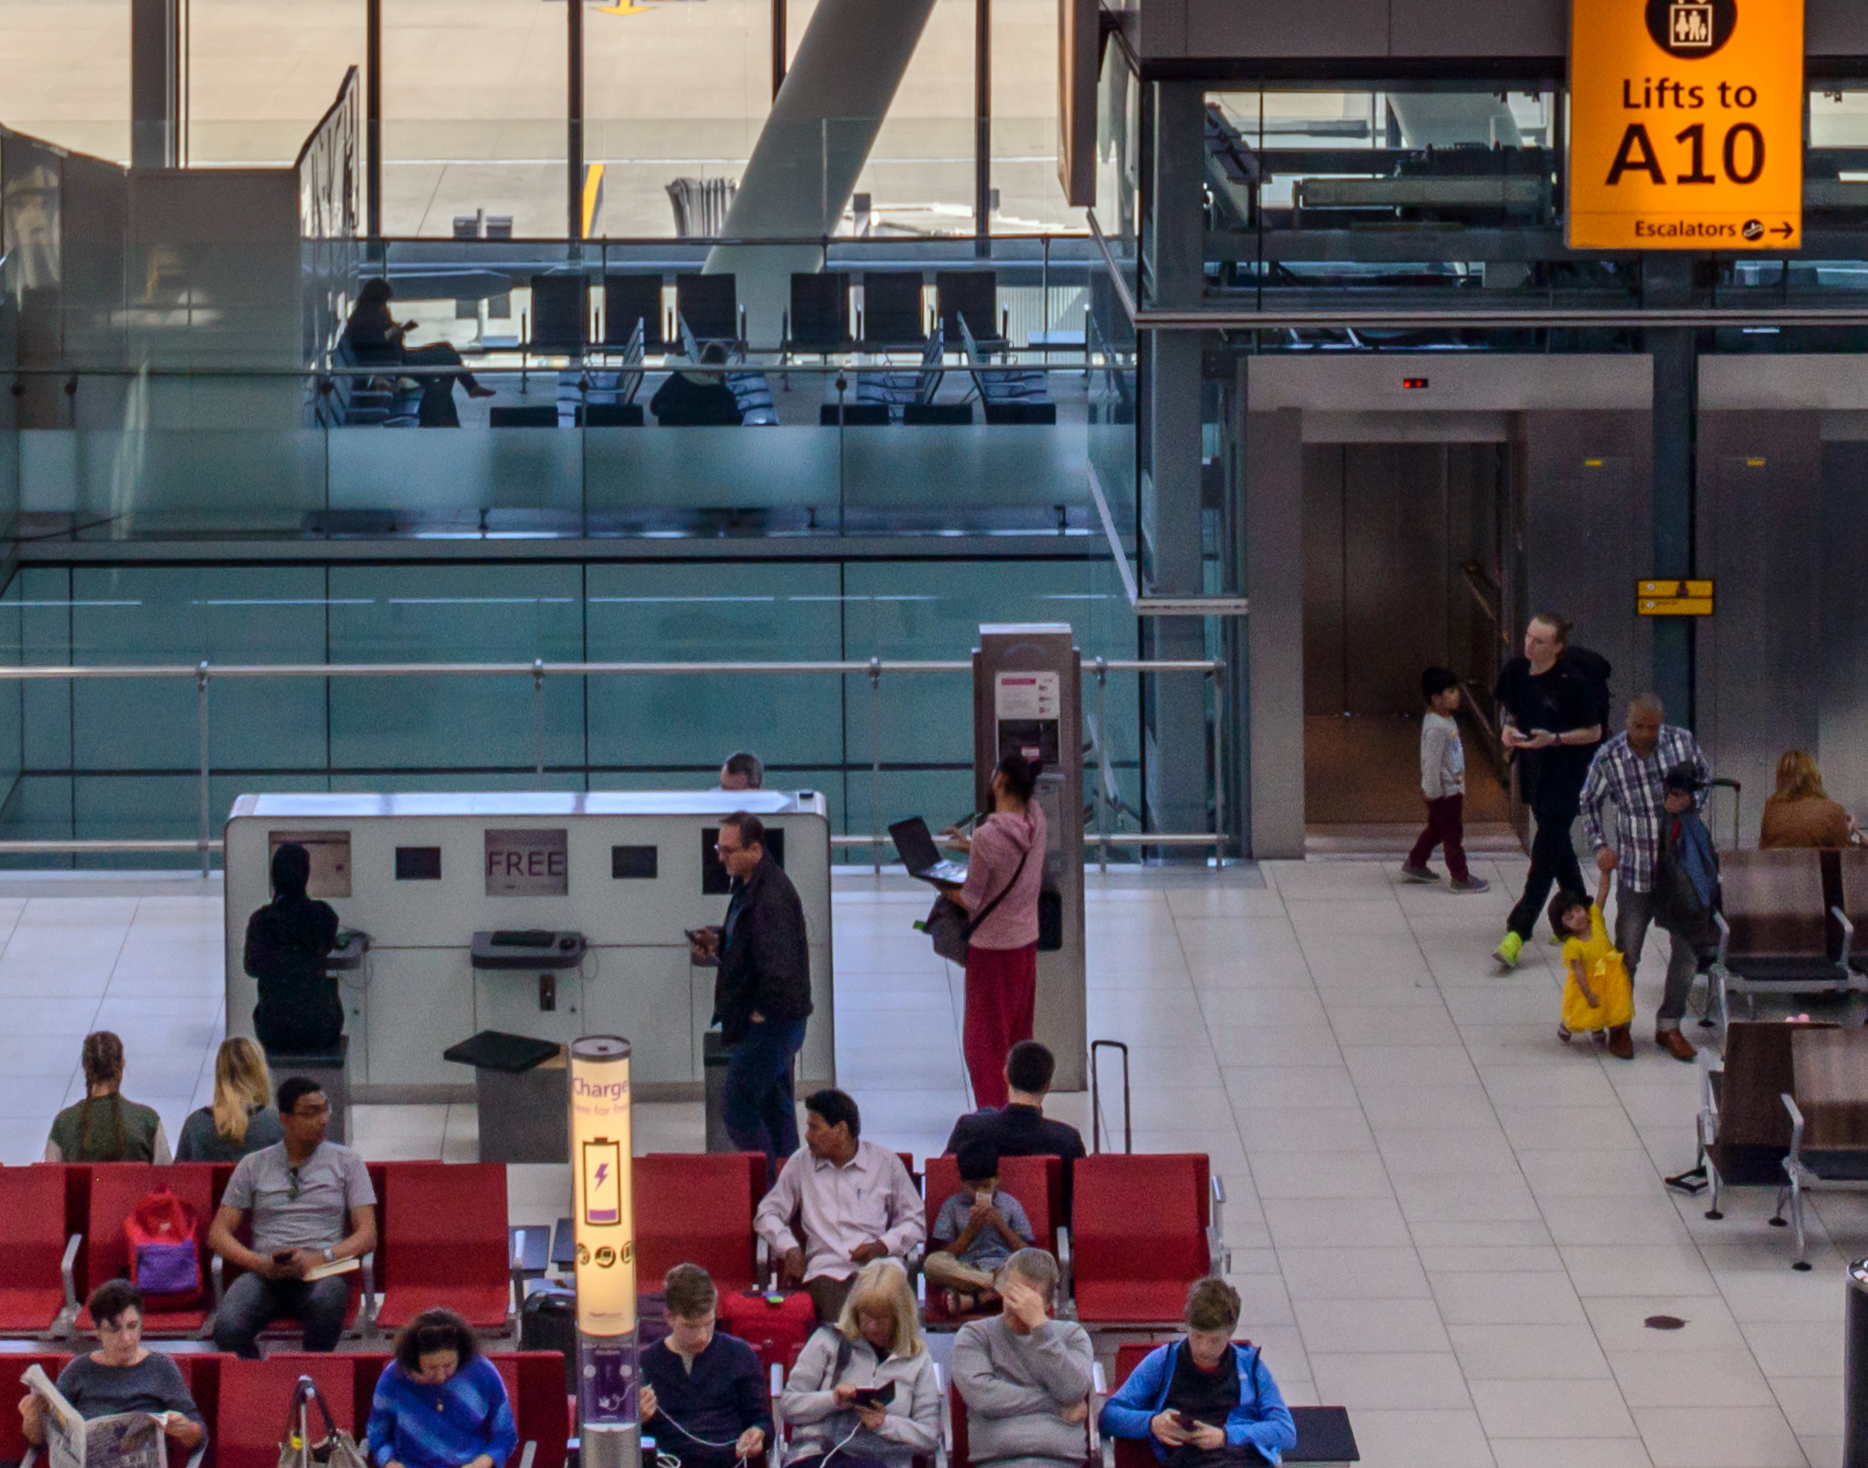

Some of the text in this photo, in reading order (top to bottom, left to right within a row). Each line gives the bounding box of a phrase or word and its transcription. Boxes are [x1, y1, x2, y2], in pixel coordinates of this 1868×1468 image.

[1623, 76, 1757, 109] Lifts to
[1604, 122, 1766, 186] A10
[1635, 220, 1737, 238] Escalators
[489, 851, 564, 877] FREE
[572, 1077, 629, 1102] Charge
